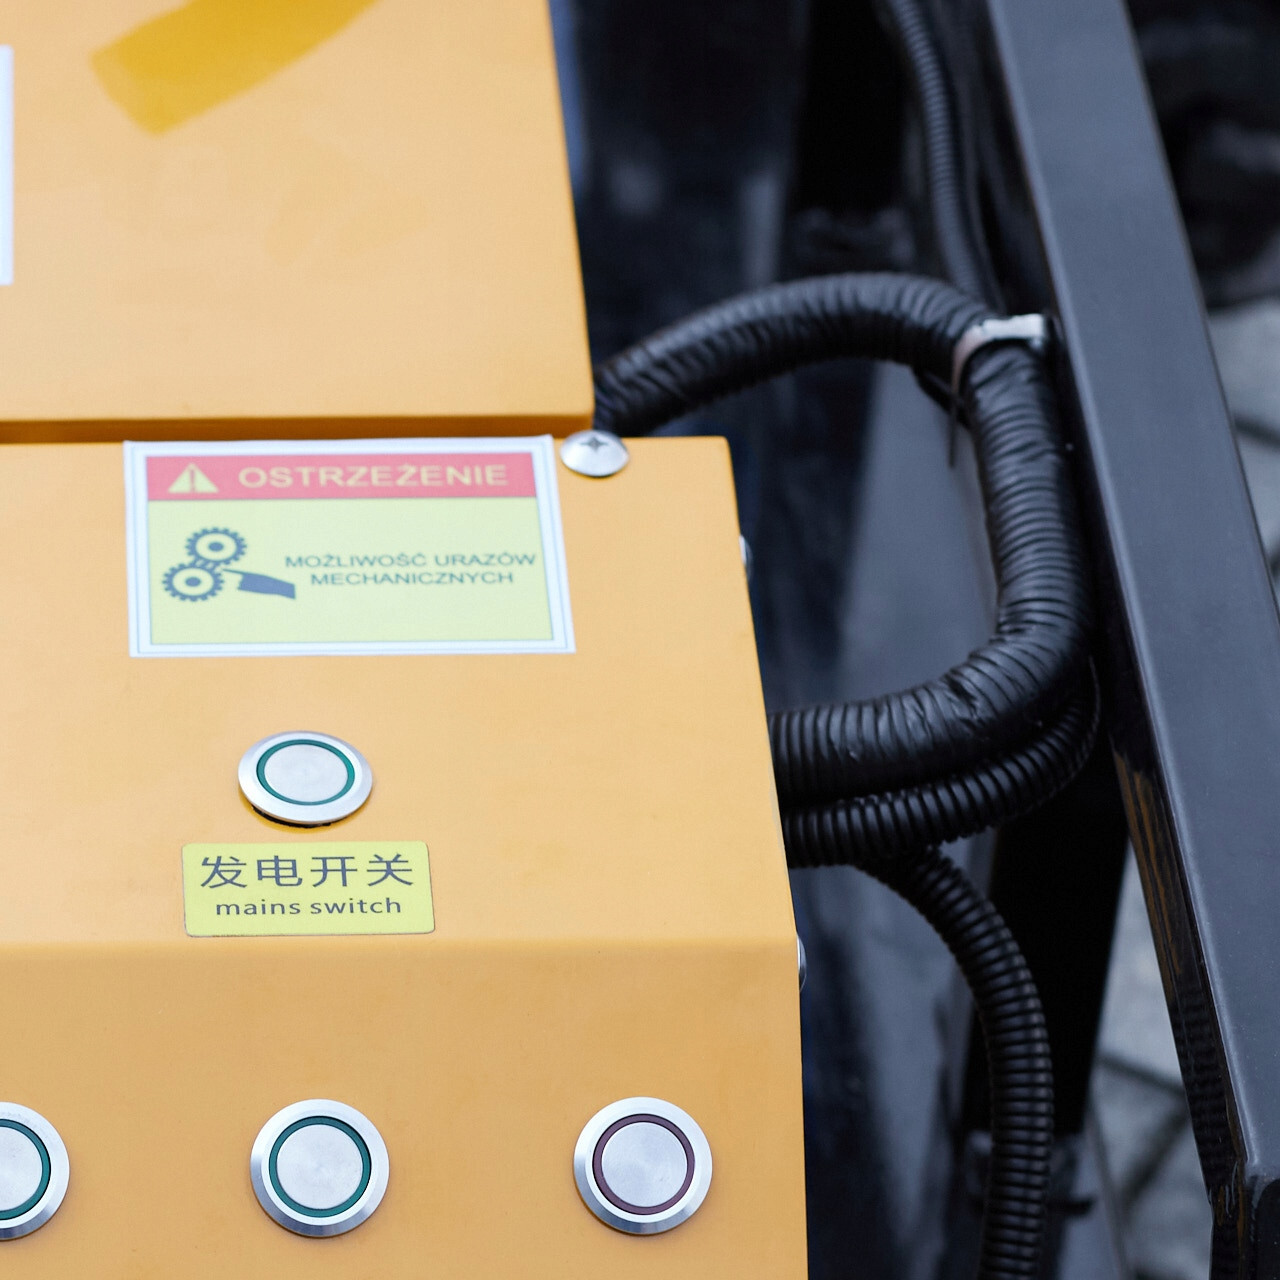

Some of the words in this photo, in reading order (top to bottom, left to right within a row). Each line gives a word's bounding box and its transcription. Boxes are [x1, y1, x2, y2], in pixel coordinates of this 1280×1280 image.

[238, 464, 507, 489] OSTRZEŻENIE
[284, 551, 428, 569] MOŻLIWOŚĆ
[433, 551, 536, 567] URAZÓW
[310, 571, 514, 586] MECHANICZNYCH
[200, 853, 414, 889] 发电开关
[216, 898, 301, 916] mains
[310, 896, 401, 915] switch
